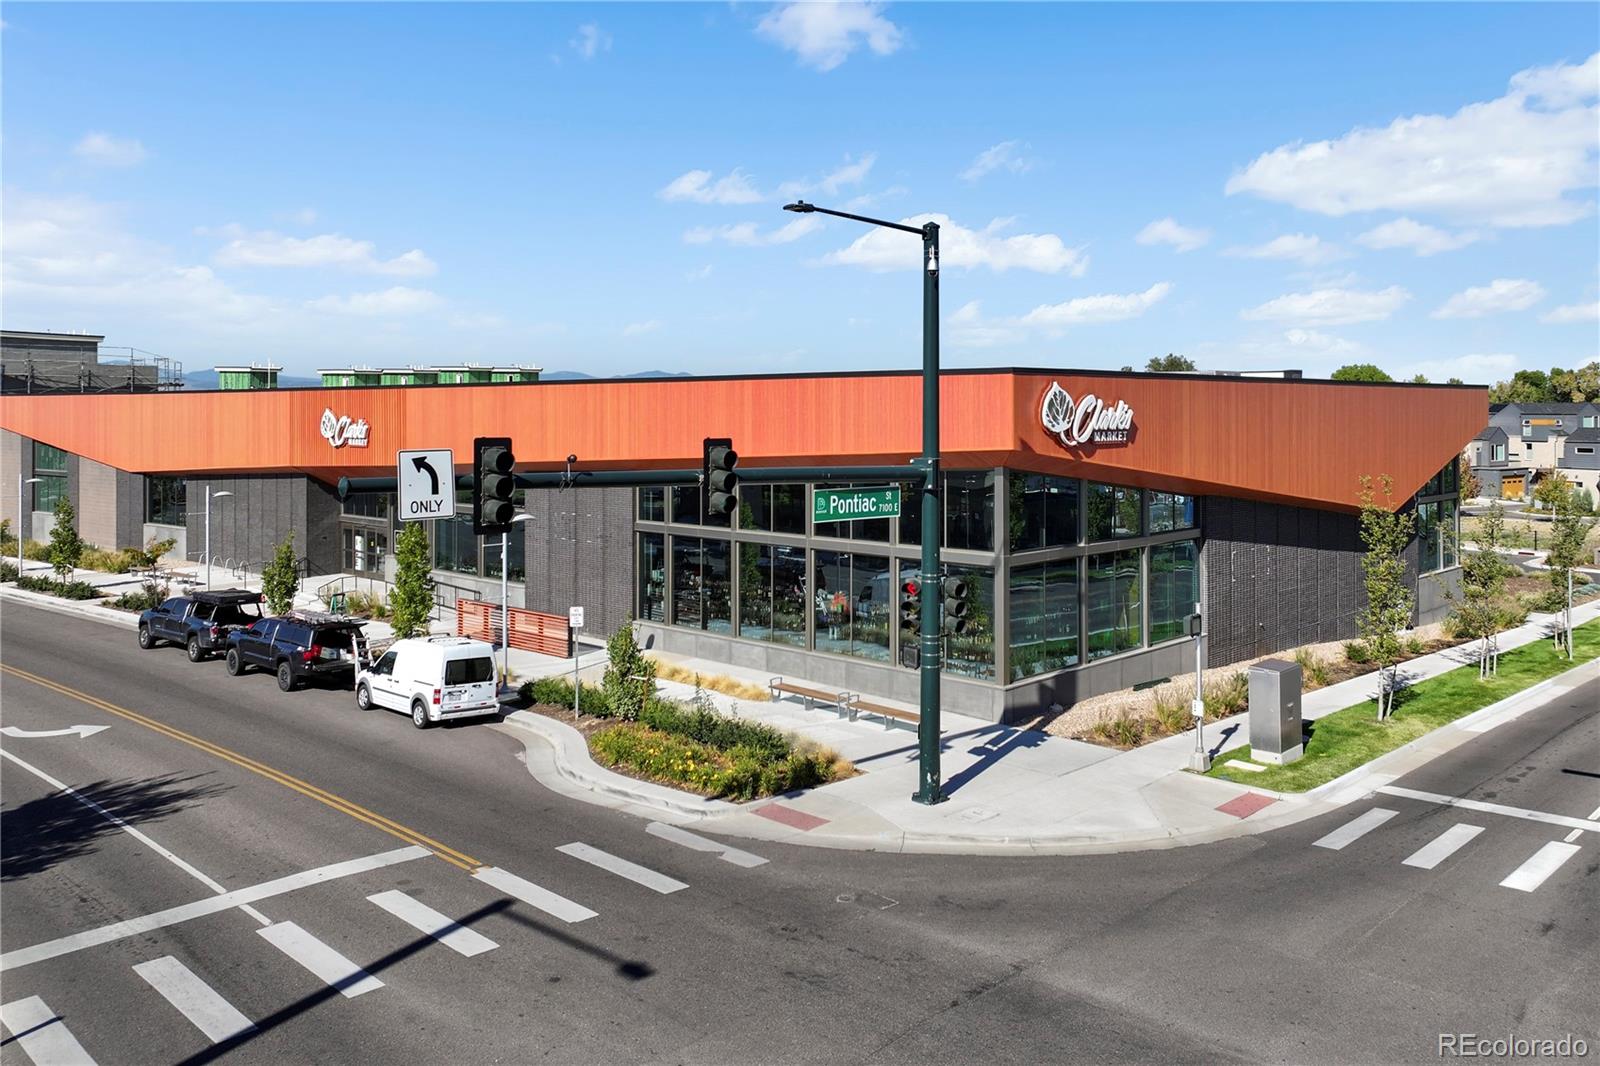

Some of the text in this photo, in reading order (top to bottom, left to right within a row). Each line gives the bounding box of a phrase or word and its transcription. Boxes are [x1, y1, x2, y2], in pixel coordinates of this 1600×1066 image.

[1073, 394, 1133, 443] Clark's
[1094, 431, 1128, 442] MARKET
[885, 491, 892, 500] St
[410, 499, 443, 514] ONLY
[830, 493, 877, 515] Pontiac
[878, 503, 893, 512] 7100
